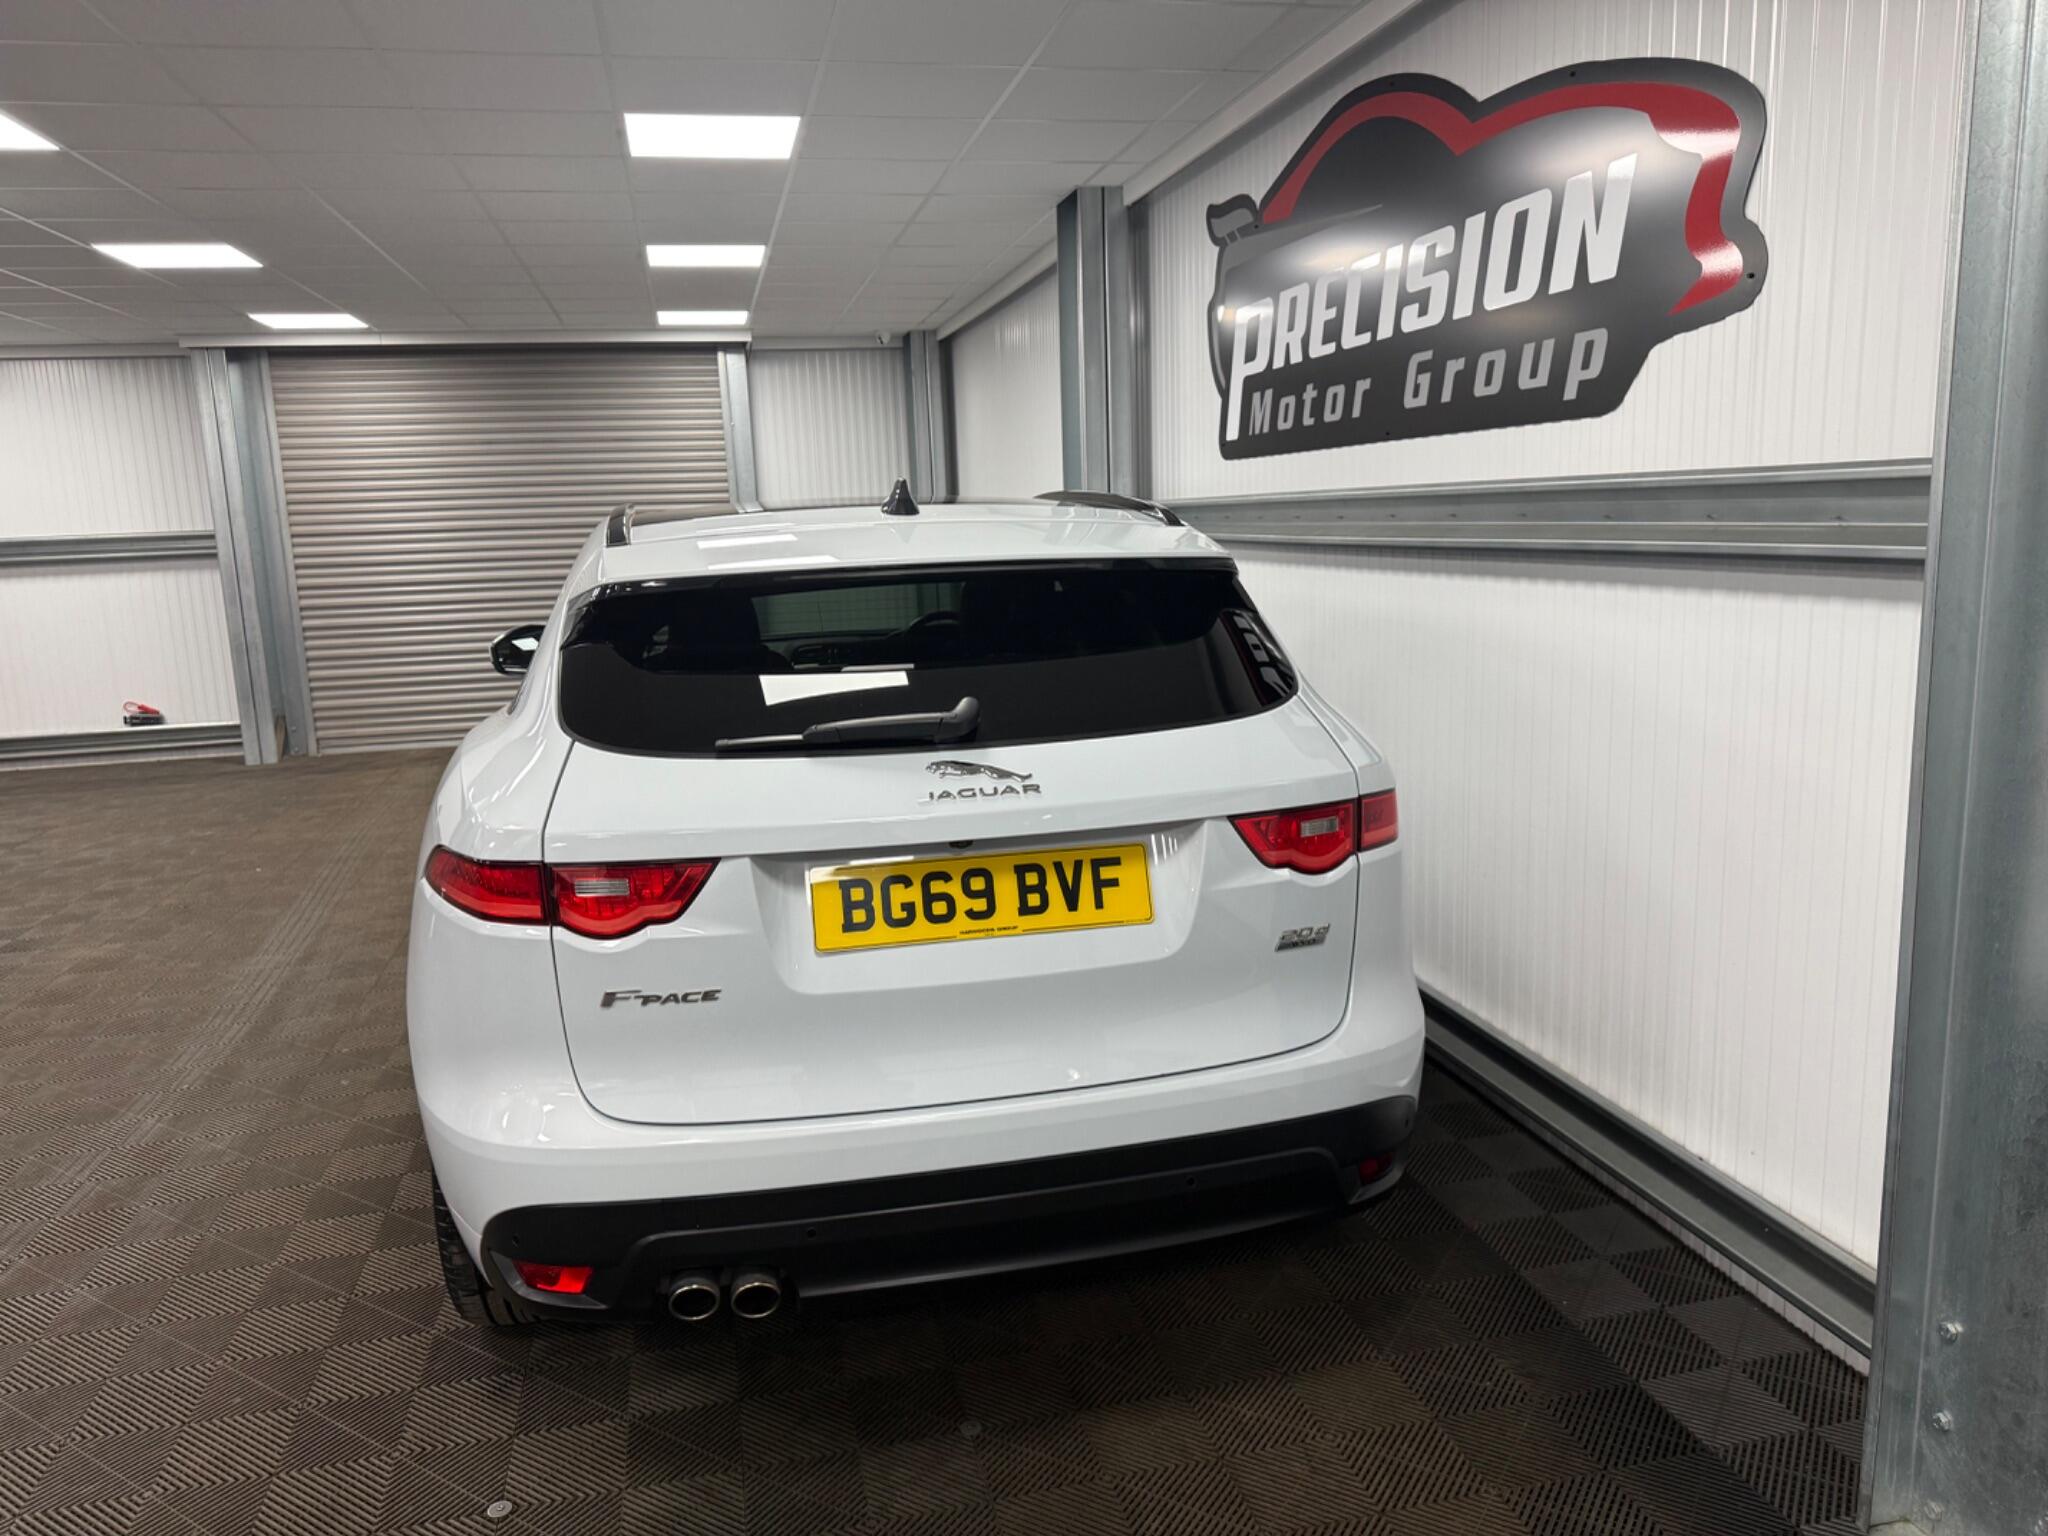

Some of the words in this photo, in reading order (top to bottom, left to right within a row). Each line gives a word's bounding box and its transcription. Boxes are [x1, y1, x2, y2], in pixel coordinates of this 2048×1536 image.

[1226, 153, 1638, 441] PRECISION
[1249, 377, 1372, 436] Motor
[1404, 328, 1609, 409] Group
[925, 784, 1042, 802] JAGUAR
[839, 867, 997, 934] BG69
[1014, 856, 1122, 917] BVF
